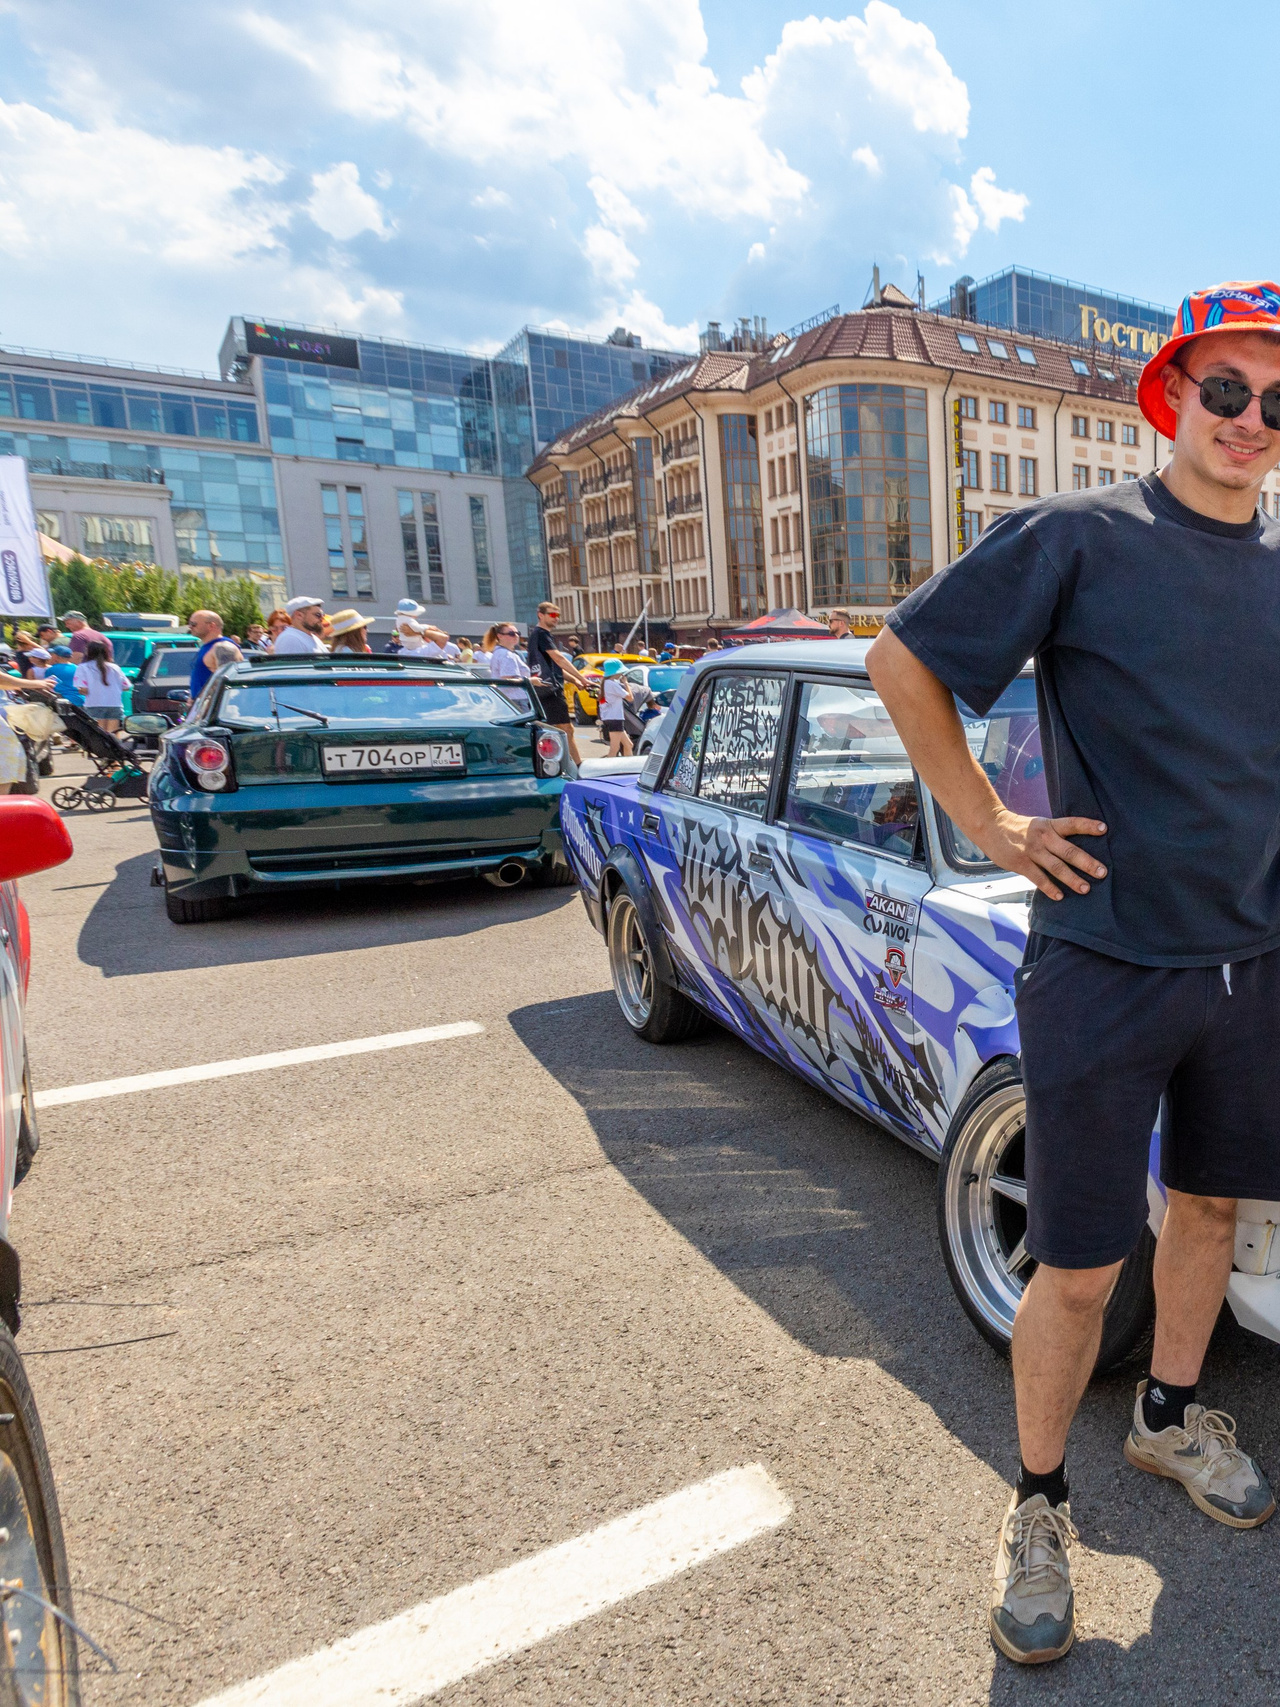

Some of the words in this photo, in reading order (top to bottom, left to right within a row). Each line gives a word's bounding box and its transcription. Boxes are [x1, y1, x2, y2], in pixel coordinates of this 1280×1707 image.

[1210, 290, 1273, 309] EXHAUST
[953, 400, 961, 467] HOTEL
[870, 894, 906, 919] AKAN
